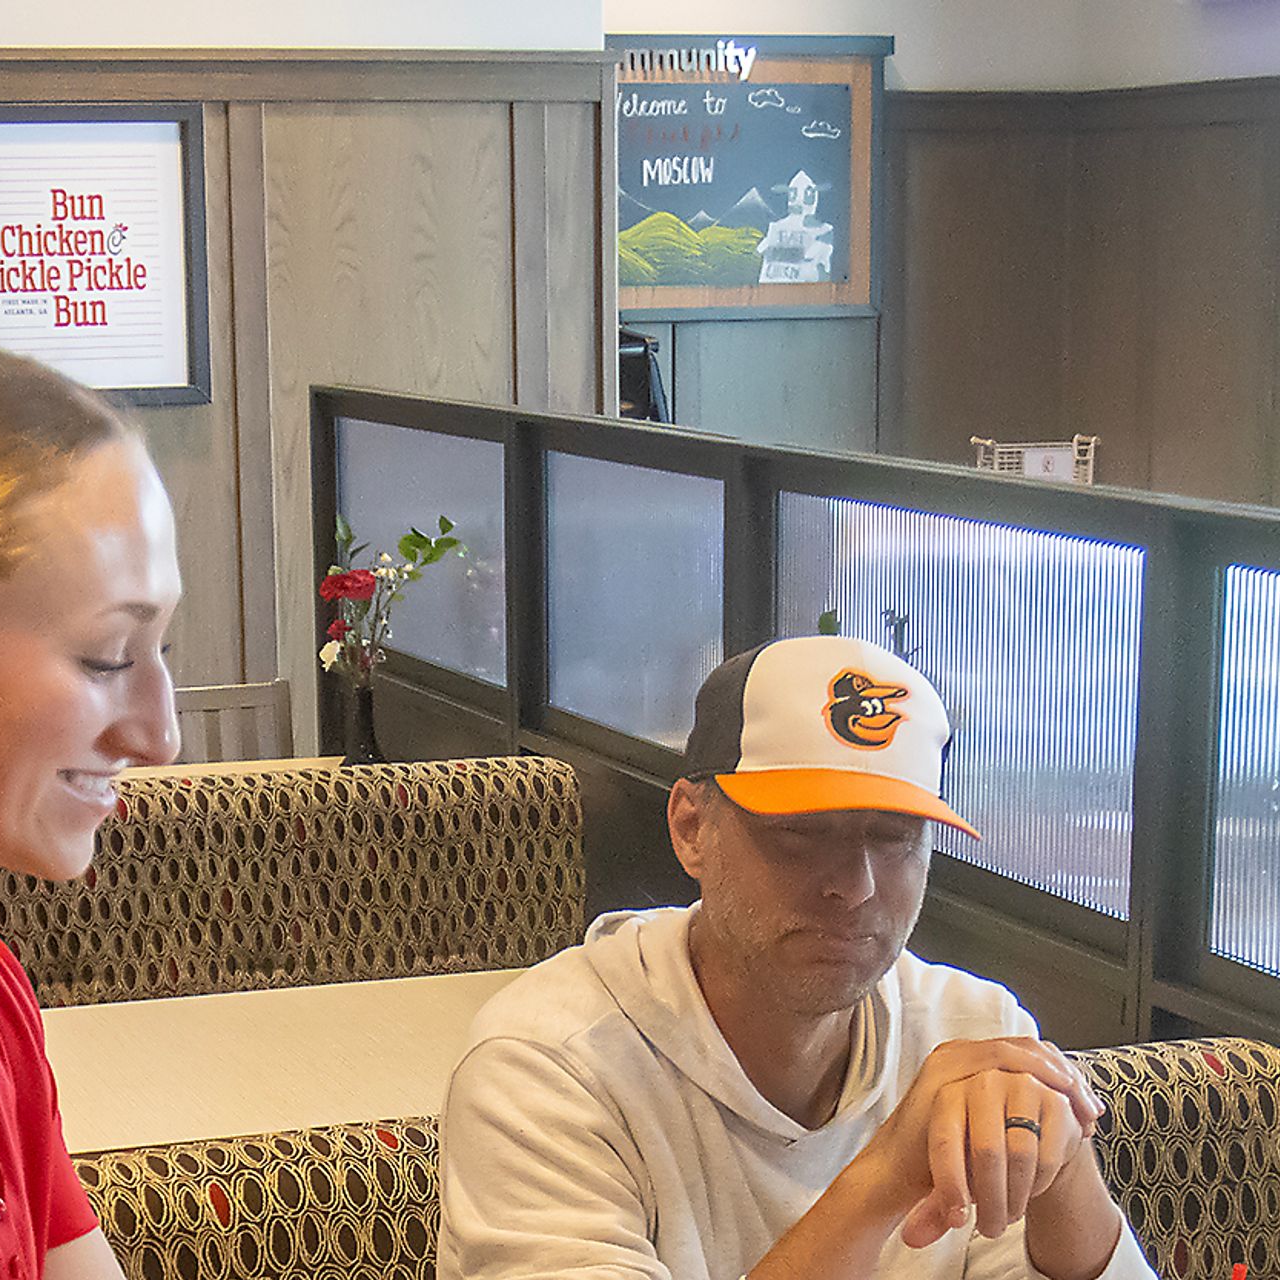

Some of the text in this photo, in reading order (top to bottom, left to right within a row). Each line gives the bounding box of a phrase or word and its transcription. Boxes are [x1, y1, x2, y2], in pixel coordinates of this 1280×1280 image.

[624, 39, 757, 81] mmunity
[703, 90, 727, 115] to
[642, 156, 715, 187] MOSCOW
[50, 188, 106, 221] Bun
[0, 223, 107, 258] Chicken
[66, 257, 147, 291] Pickle
[53, 295, 108, 327] Bun
